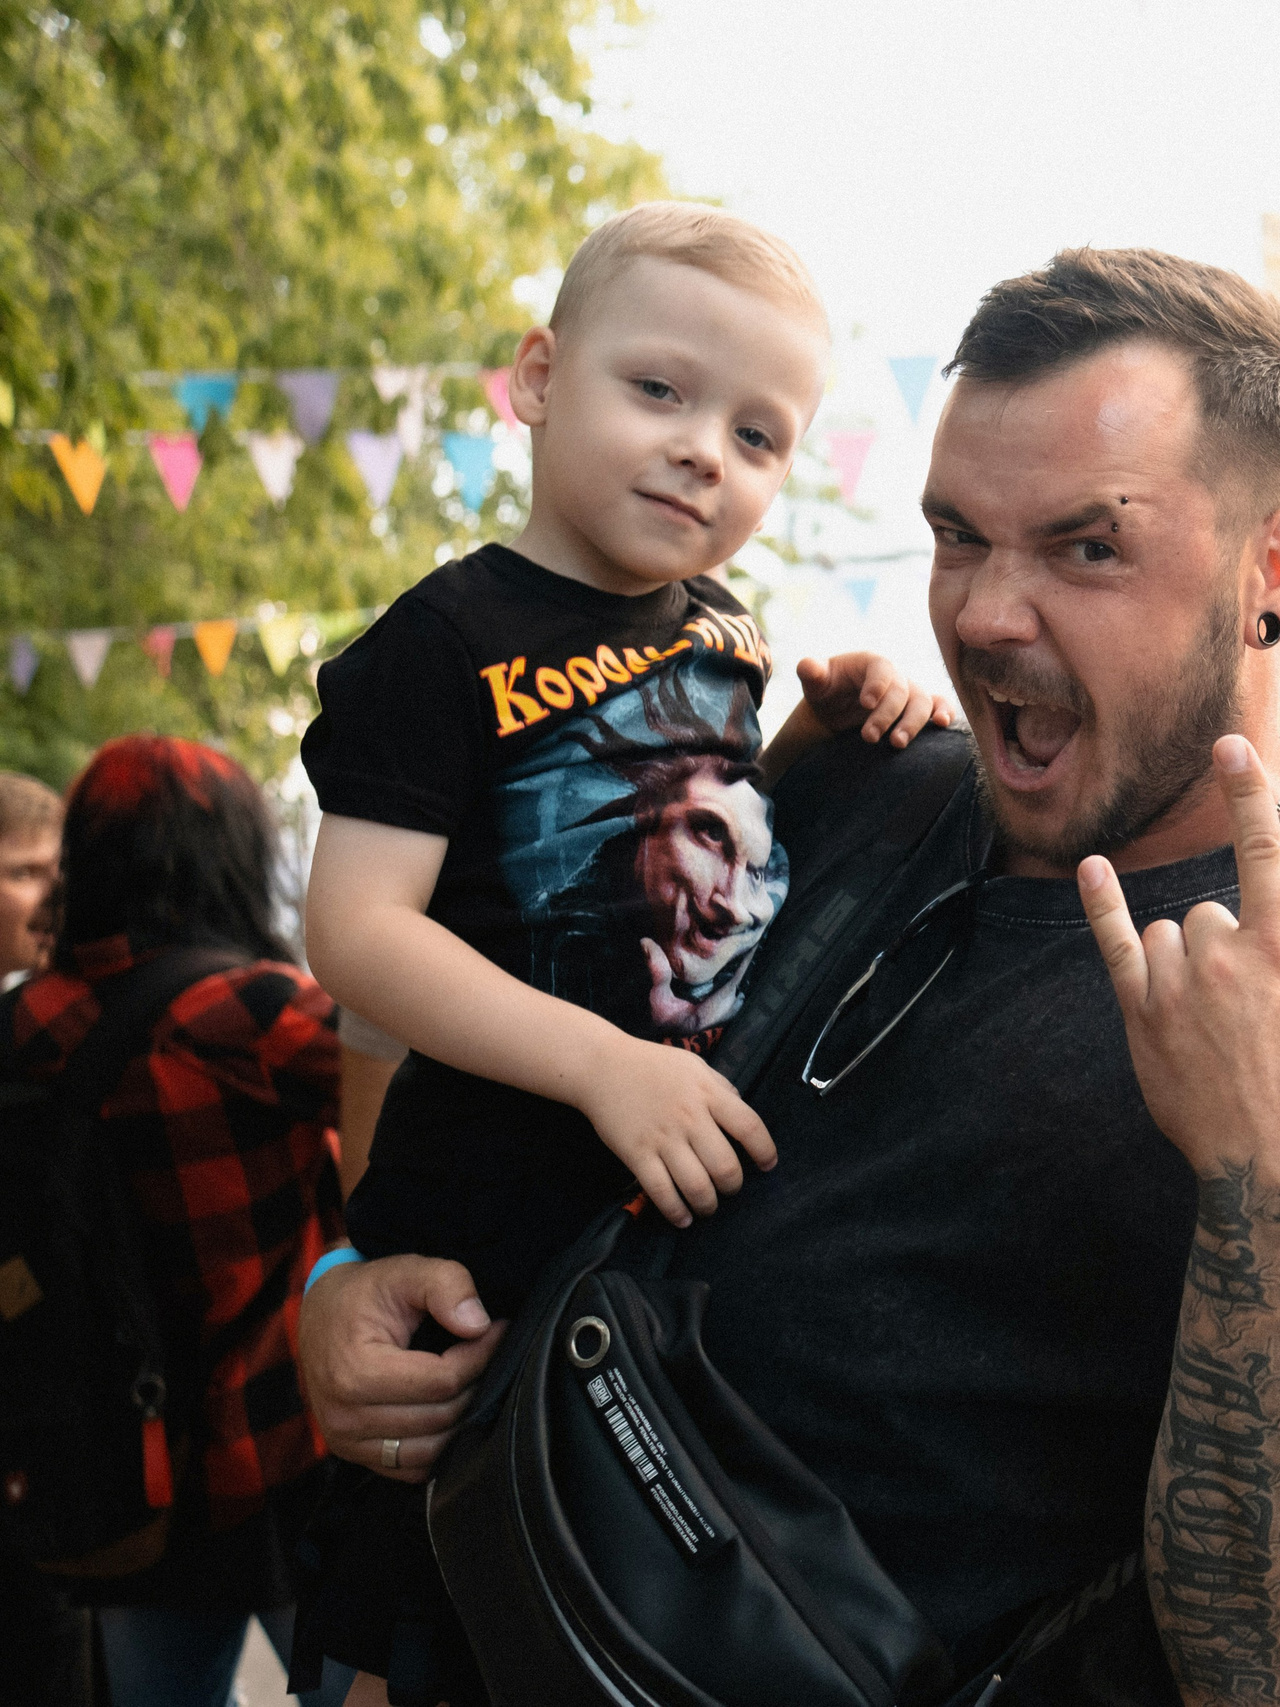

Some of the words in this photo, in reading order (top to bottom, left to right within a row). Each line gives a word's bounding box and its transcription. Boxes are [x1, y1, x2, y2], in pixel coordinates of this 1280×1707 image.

[592, 1380, 608, 1402] SKRM
[624, 1402, 641, 1427] CRIMINAL
[638, 1425, 659, 1455] PENALTIES
[655, 1453, 669, 1470] APPLY
